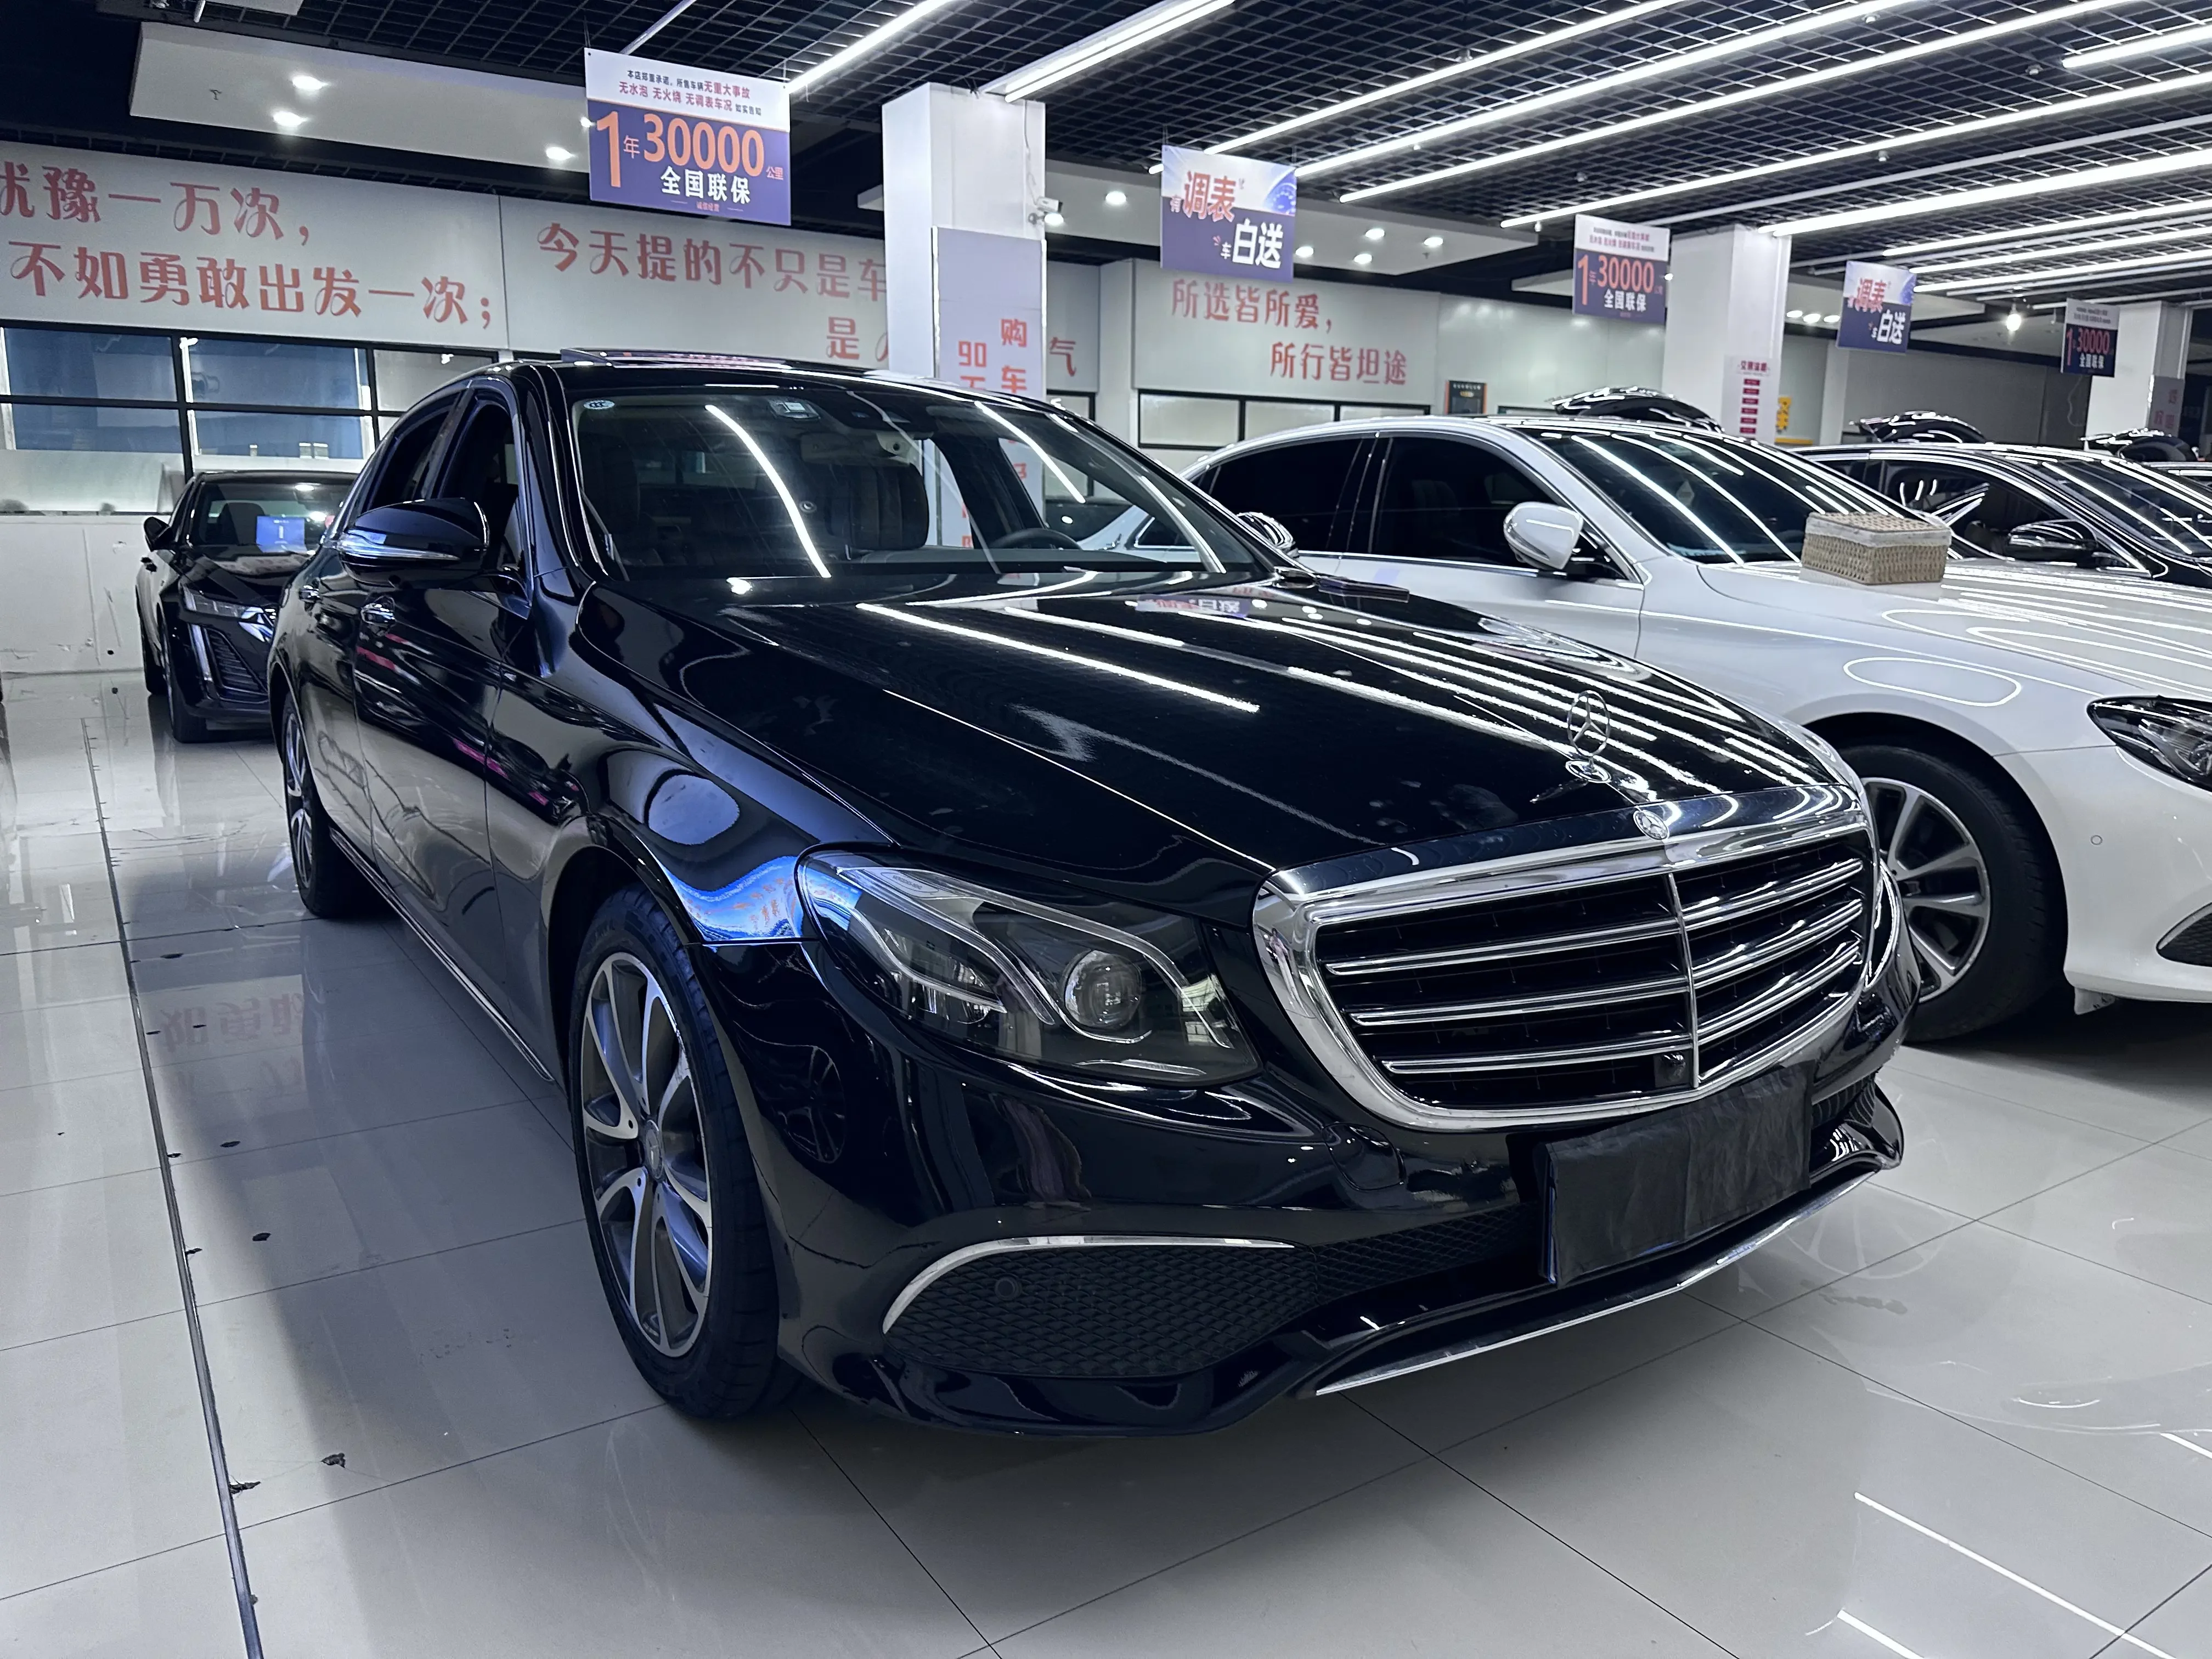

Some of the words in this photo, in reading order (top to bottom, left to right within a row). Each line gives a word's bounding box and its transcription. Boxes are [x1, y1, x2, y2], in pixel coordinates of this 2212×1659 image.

[644, 113, 764, 177] 30000
[661, 166, 751, 205] 全国联保
[9, 241, 491, 329] 不如勇敢出发一次；
[538, 223, 887, 301] 今天提的不只是车
[1598, 255, 1654, 293] 30000
[1172, 279, 1332, 333] 所选皆所爱，
[1271, 341, 1407, 385] 所行皆坦途
